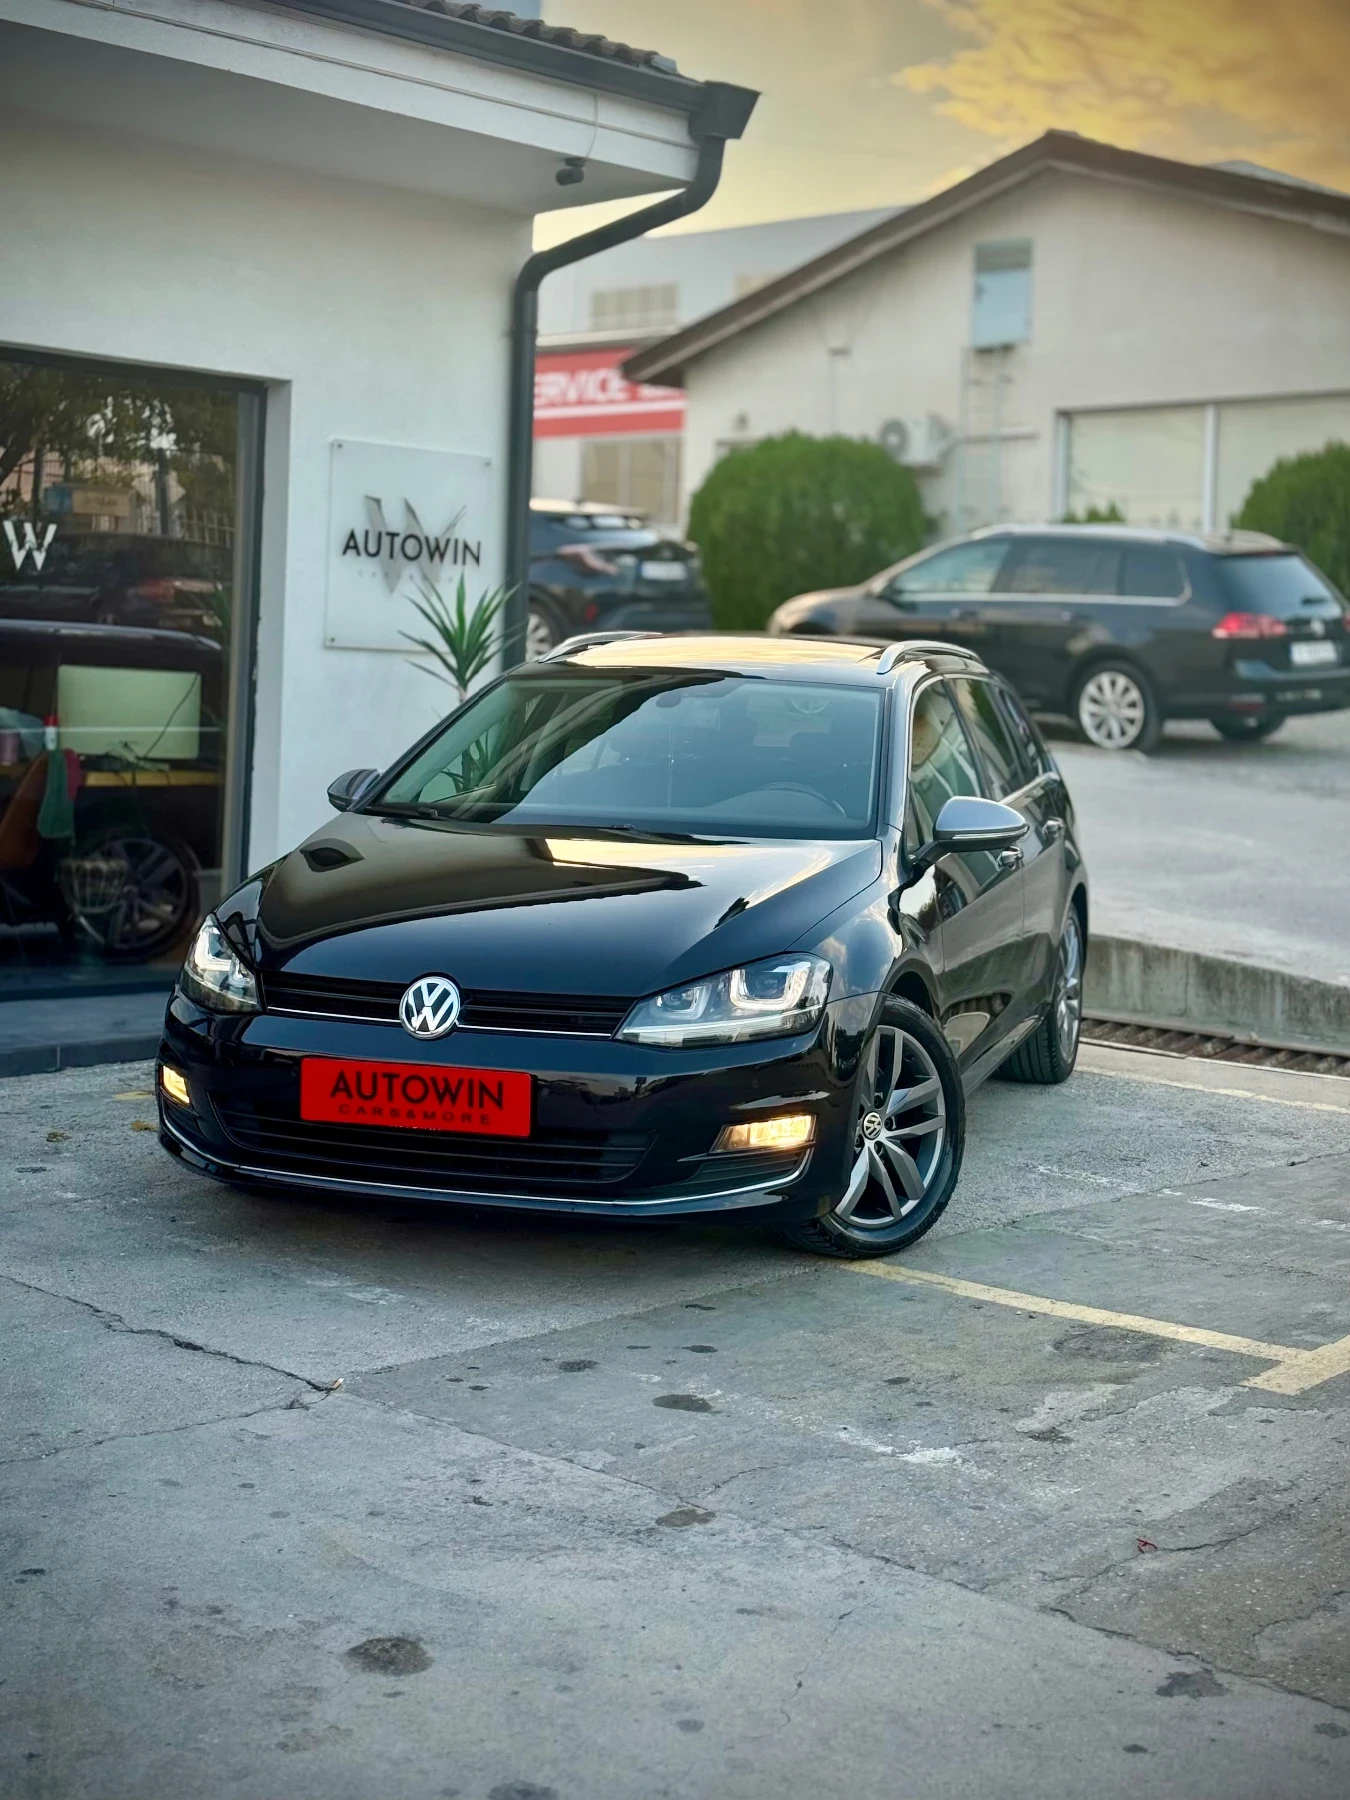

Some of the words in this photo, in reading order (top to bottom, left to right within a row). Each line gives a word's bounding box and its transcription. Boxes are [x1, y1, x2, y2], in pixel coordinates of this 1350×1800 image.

[342, 528, 481, 566] AUTOWIN
[402, 978, 460, 1037] VW
[330, 1070, 504, 1110] AUTOWIN
